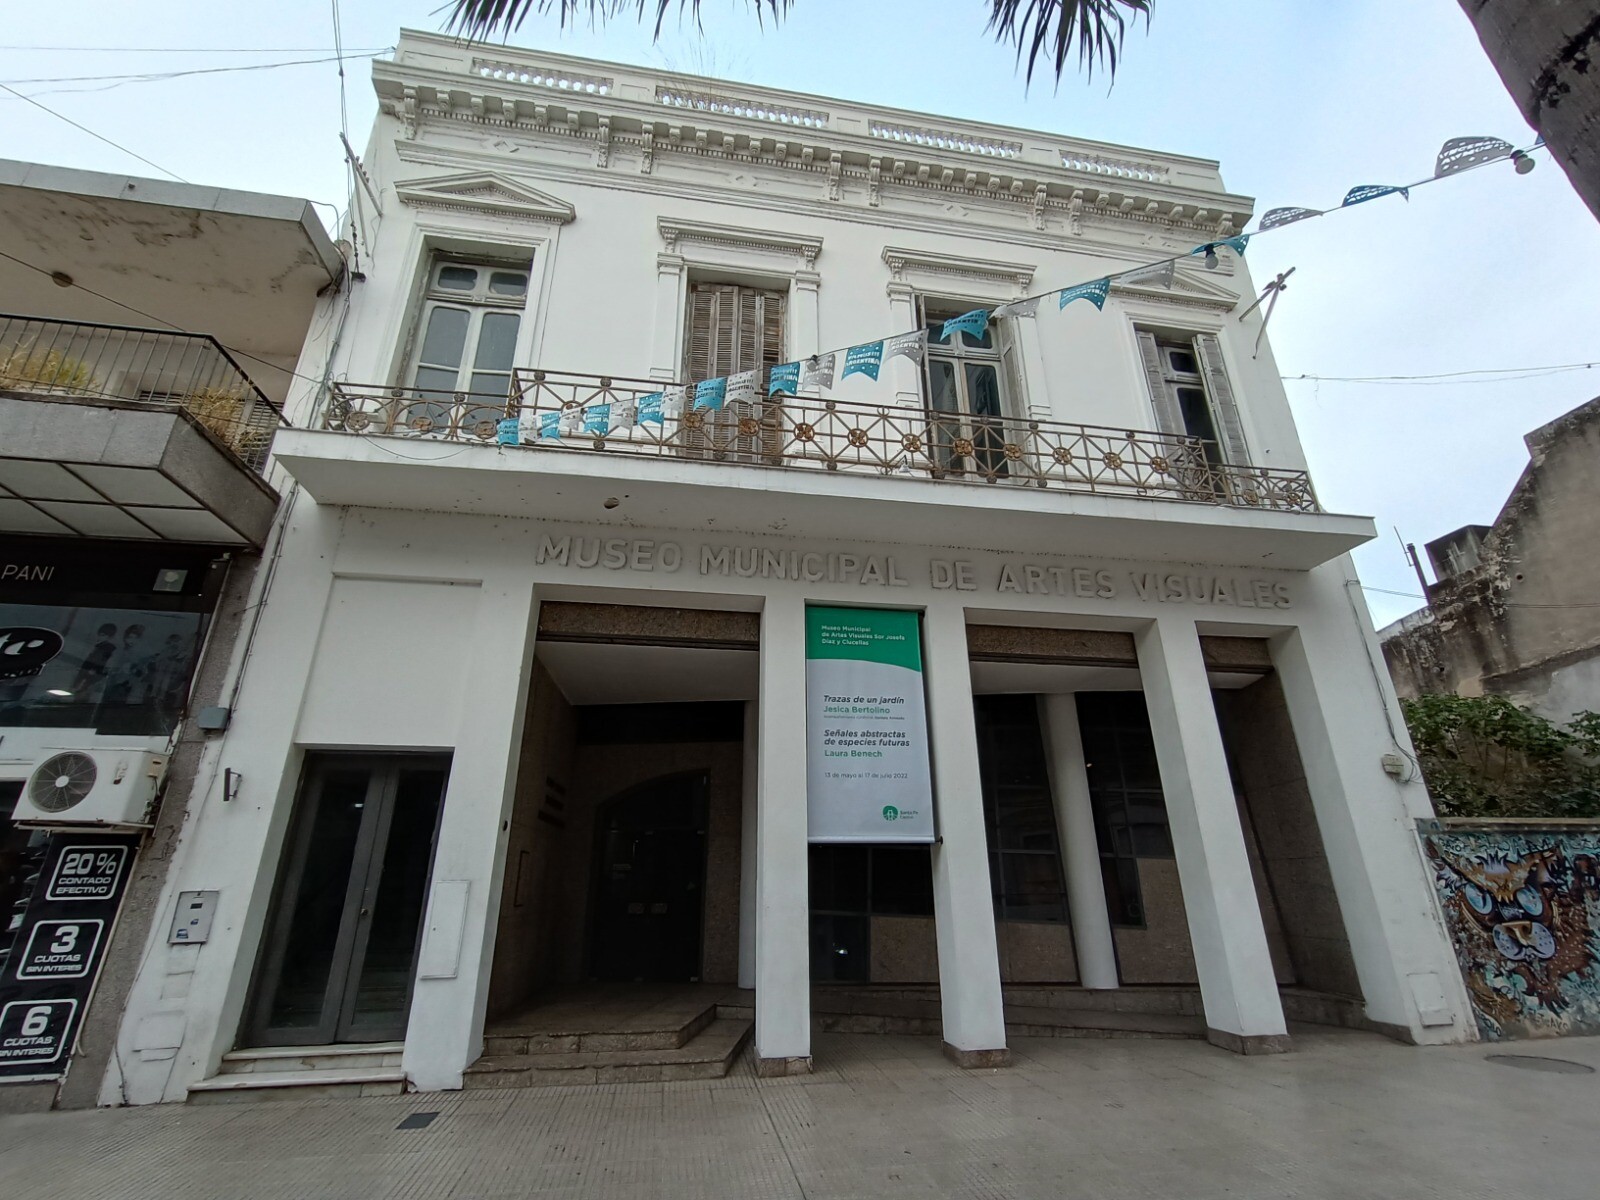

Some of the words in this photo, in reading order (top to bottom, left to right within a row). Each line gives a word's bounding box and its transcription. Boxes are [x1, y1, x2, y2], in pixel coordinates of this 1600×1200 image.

[534, 533, 682, 573] MUSEO
[699, 544, 910, 588] MUNICIPAL
[930, 559, 978, 591] DE
[997, 563, 1119, 599] ARTES
[1129, 570, 1294, 611] VISUALES
[823, 695, 851, 703] Trazas
[879, 696, 905, 705] jardín
[852, 706, 890, 714] Bertolino
[823, 729, 858, 738] Señales
[860, 730, 906, 738] abstractas
[824, 738, 836, 746] de
[838, 739, 876, 747] especies
[878, 739, 910, 747] futuras
[851, 750, 882, 758] Benech
[55, 886, 108, 894] EFECTIVO
[50, 925, 80, 953] 3
[34, 954, 81, 963] CUOTAS
[25, 965, 43, 973] SIN
[43, 964, 83, 972] INTERES
[21, 1005, 52, 1036] 6
[3, 1036, 53, 1047] CUOTAS
[12, 1047, 54, 1057] INTERES
